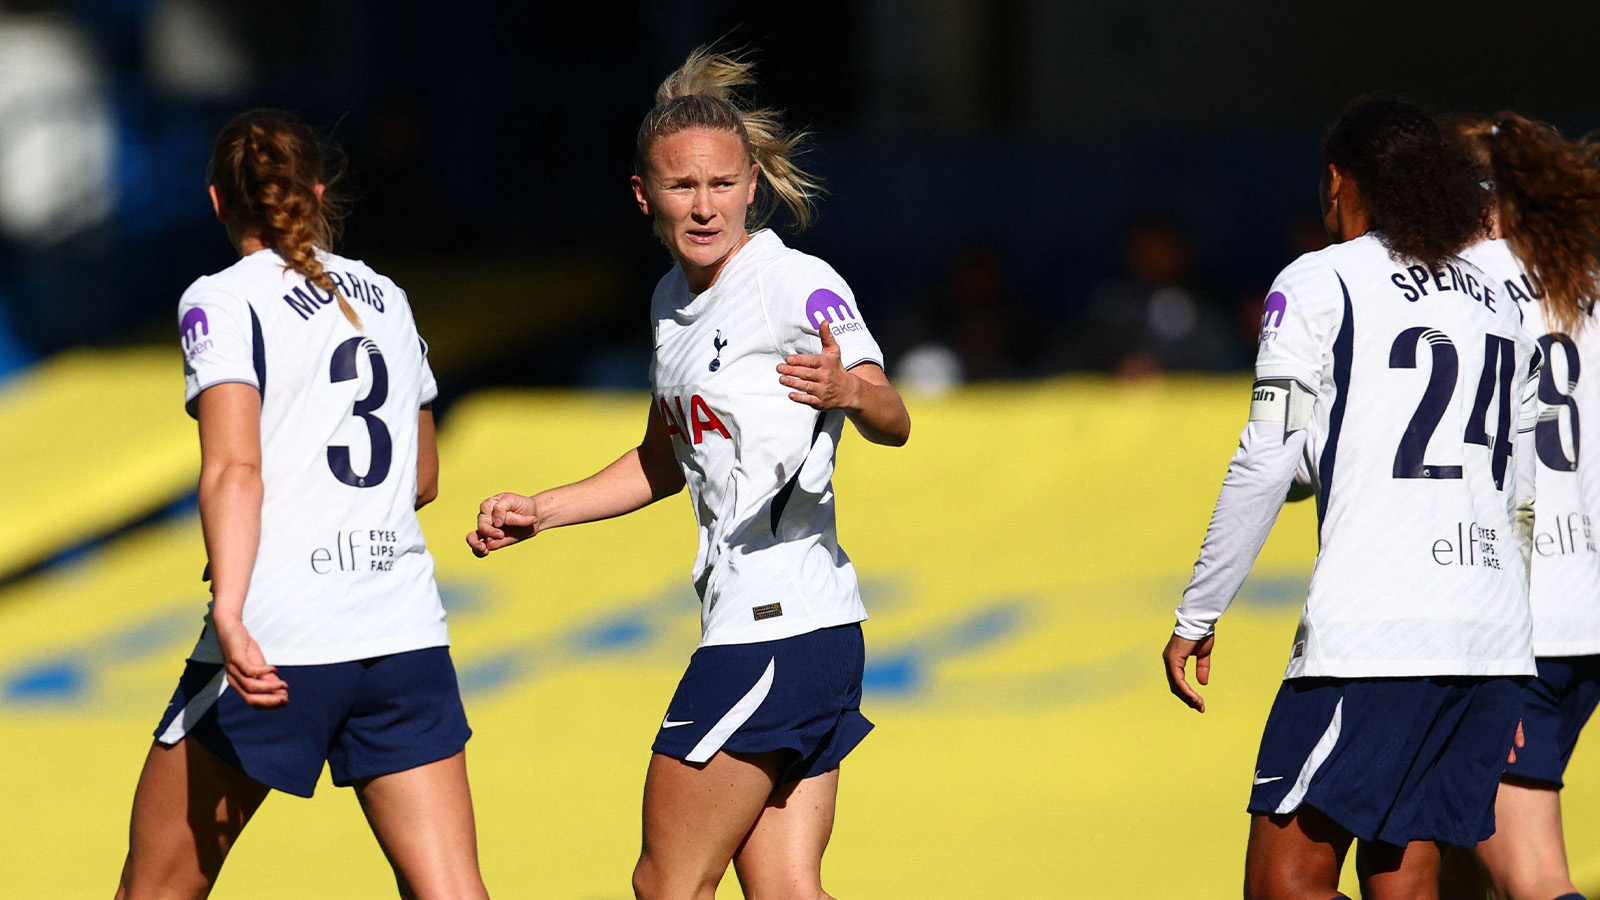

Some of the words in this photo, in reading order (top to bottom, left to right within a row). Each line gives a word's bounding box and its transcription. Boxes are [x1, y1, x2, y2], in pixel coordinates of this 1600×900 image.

[283, 271, 385, 322] MORRIS
[1390, 263, 1497, 314] SPENCE
[831, 321, 864, 336] aken
[326, 335, 393, 489] 3
[659, 394, 732, 445] AIA
[1388, 326, 1516, 492] 24
